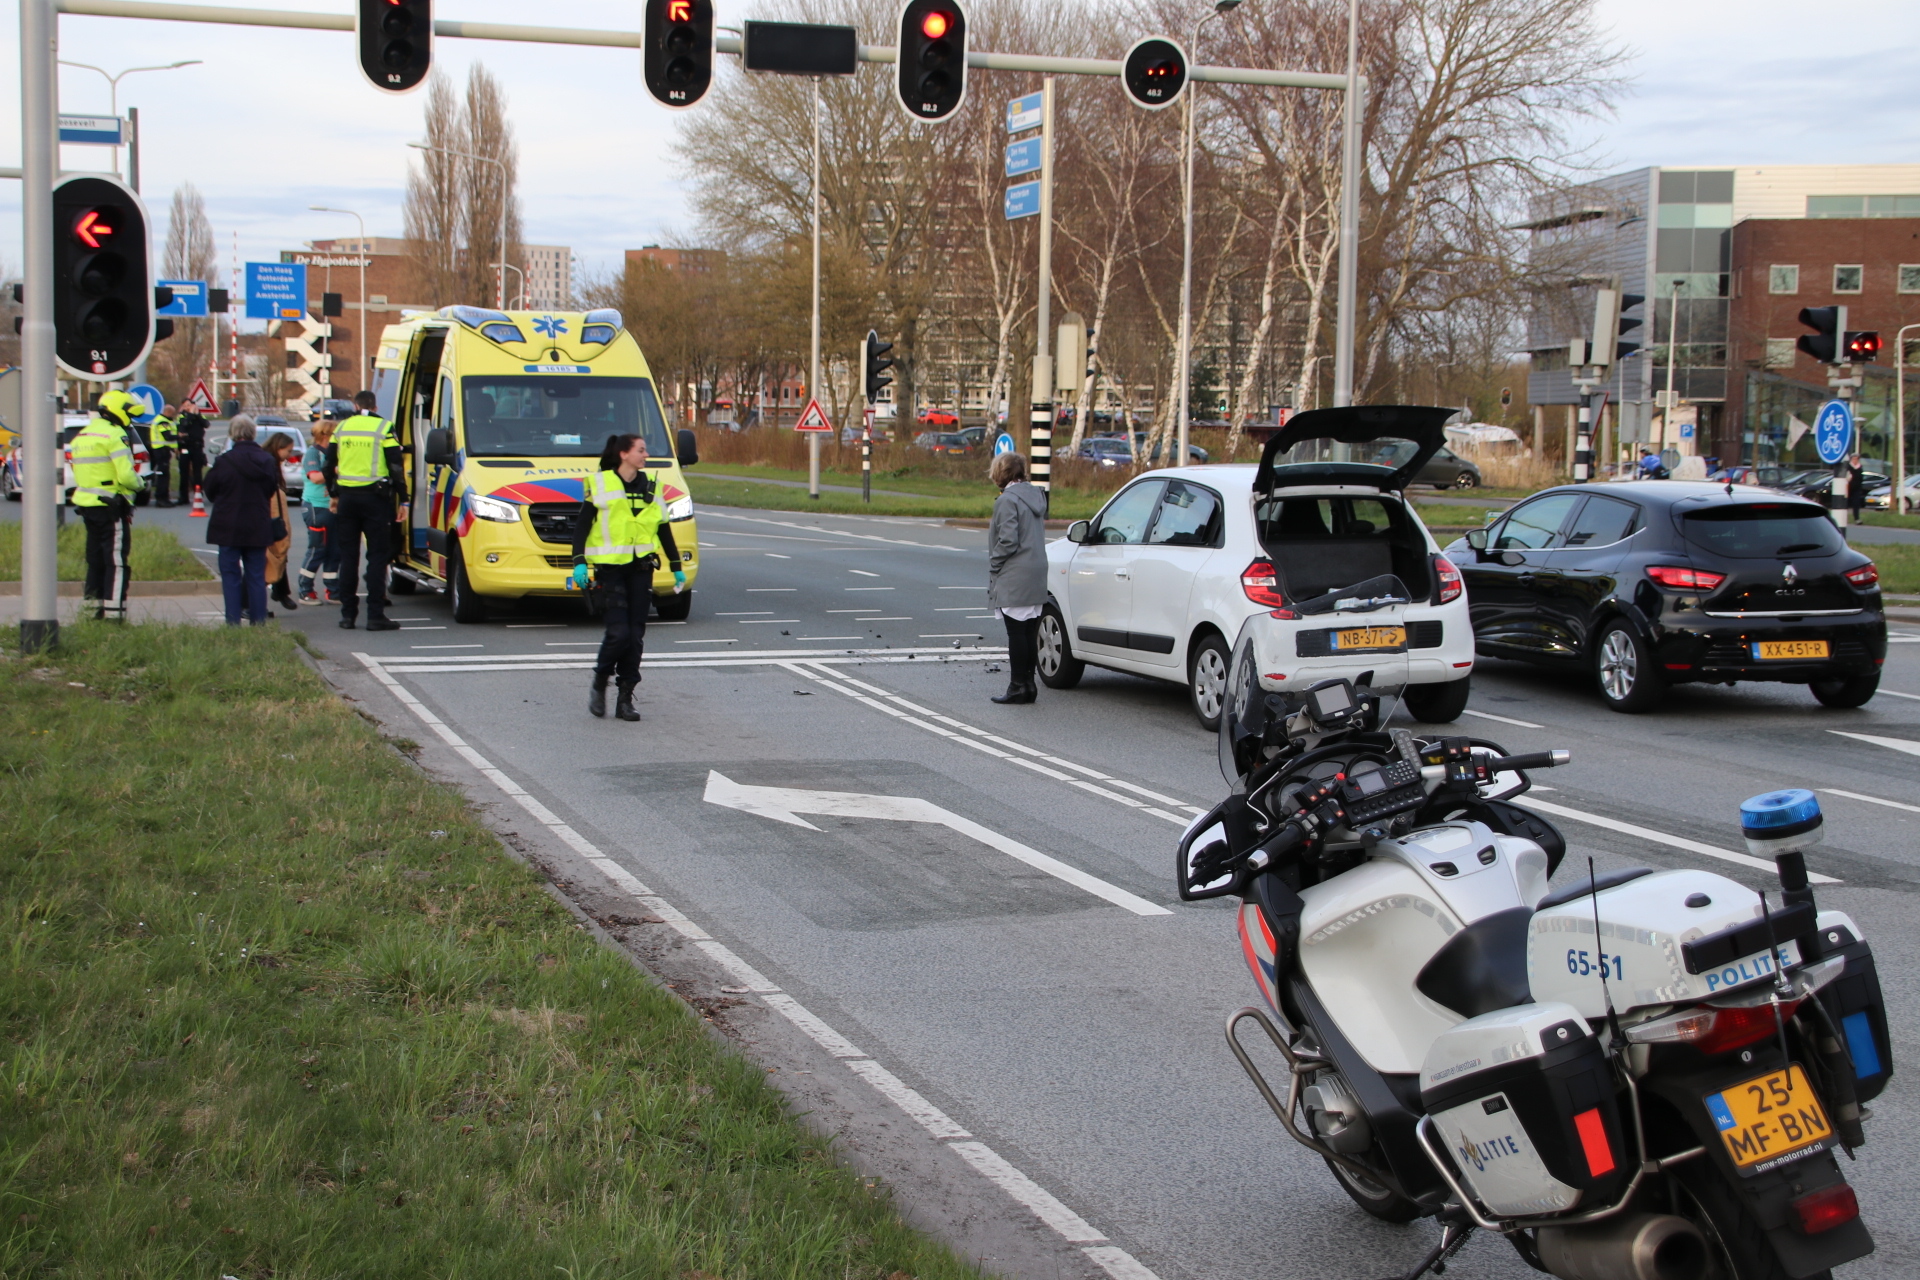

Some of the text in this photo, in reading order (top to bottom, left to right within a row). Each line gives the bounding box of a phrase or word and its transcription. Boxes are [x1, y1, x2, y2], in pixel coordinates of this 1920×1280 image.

[59, 119, 96, 128] oosevelt
[311, 255, 371, 267] Hypothekr
[258, 265, 293, 275] Den Haag
[257, 274, 295, 283] Rotterdam
[262, 283, 290, 291] Utrecht
[255, 291, 297, 300] Amsterdam
[90, 349, 108, 361] 9.1
[1774, 588, 1806, 596] CLIO
[1342, 628, 1398, 646] NB-371S
[1765, 642, 1823, 656] XX-451-R
[1567, 948, 1623, 981] 65-51
[1705, 948, 1792, 992] POLITE
[1746, 1076, 1791, 1115] 25
[1717, 1115, 1731, 1125] NL
[1726, 1104, 1825, 1161] MF-BN
[1755, 1141, 1823, 1172] bmw-motorrad.nl
